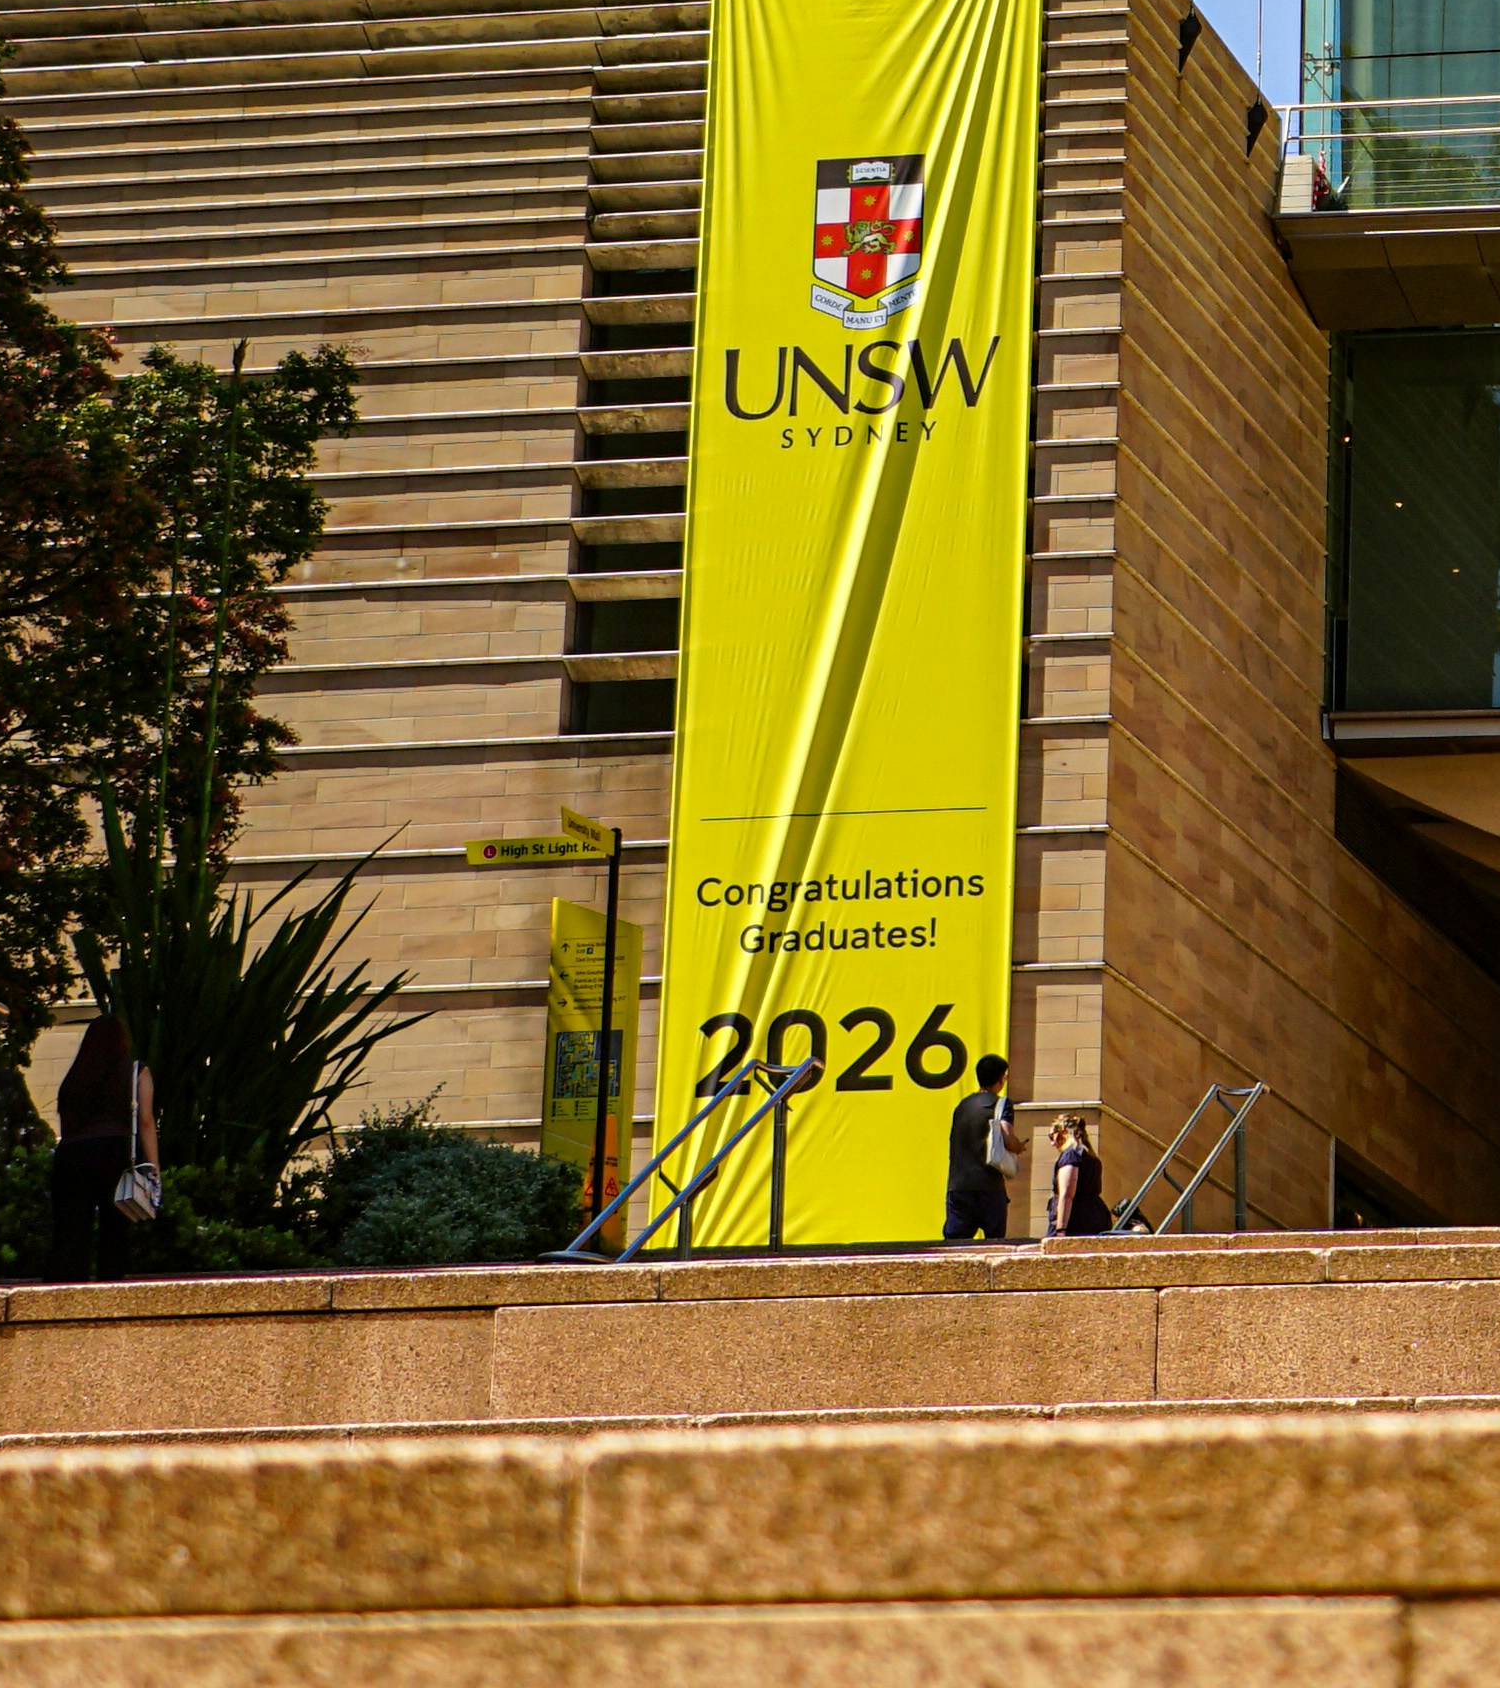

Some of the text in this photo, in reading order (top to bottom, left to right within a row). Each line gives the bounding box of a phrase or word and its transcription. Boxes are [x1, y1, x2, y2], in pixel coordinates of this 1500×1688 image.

[845, 316, 873, 325] MANU
[725, 335, 1000, 420] UNSW
[781, 421, 936, 449] SYDNEY
[501, 843, 529, 859] High
[532, 844, 545, 854] St
[549, 842, 579, 856] Light
[582, 841, 602, 852] Ra
[696, 869, 985, 913] Congratulations
[740, 917, 937, 954] Graduates!
[695, 1003, 968, 1098] 2026
